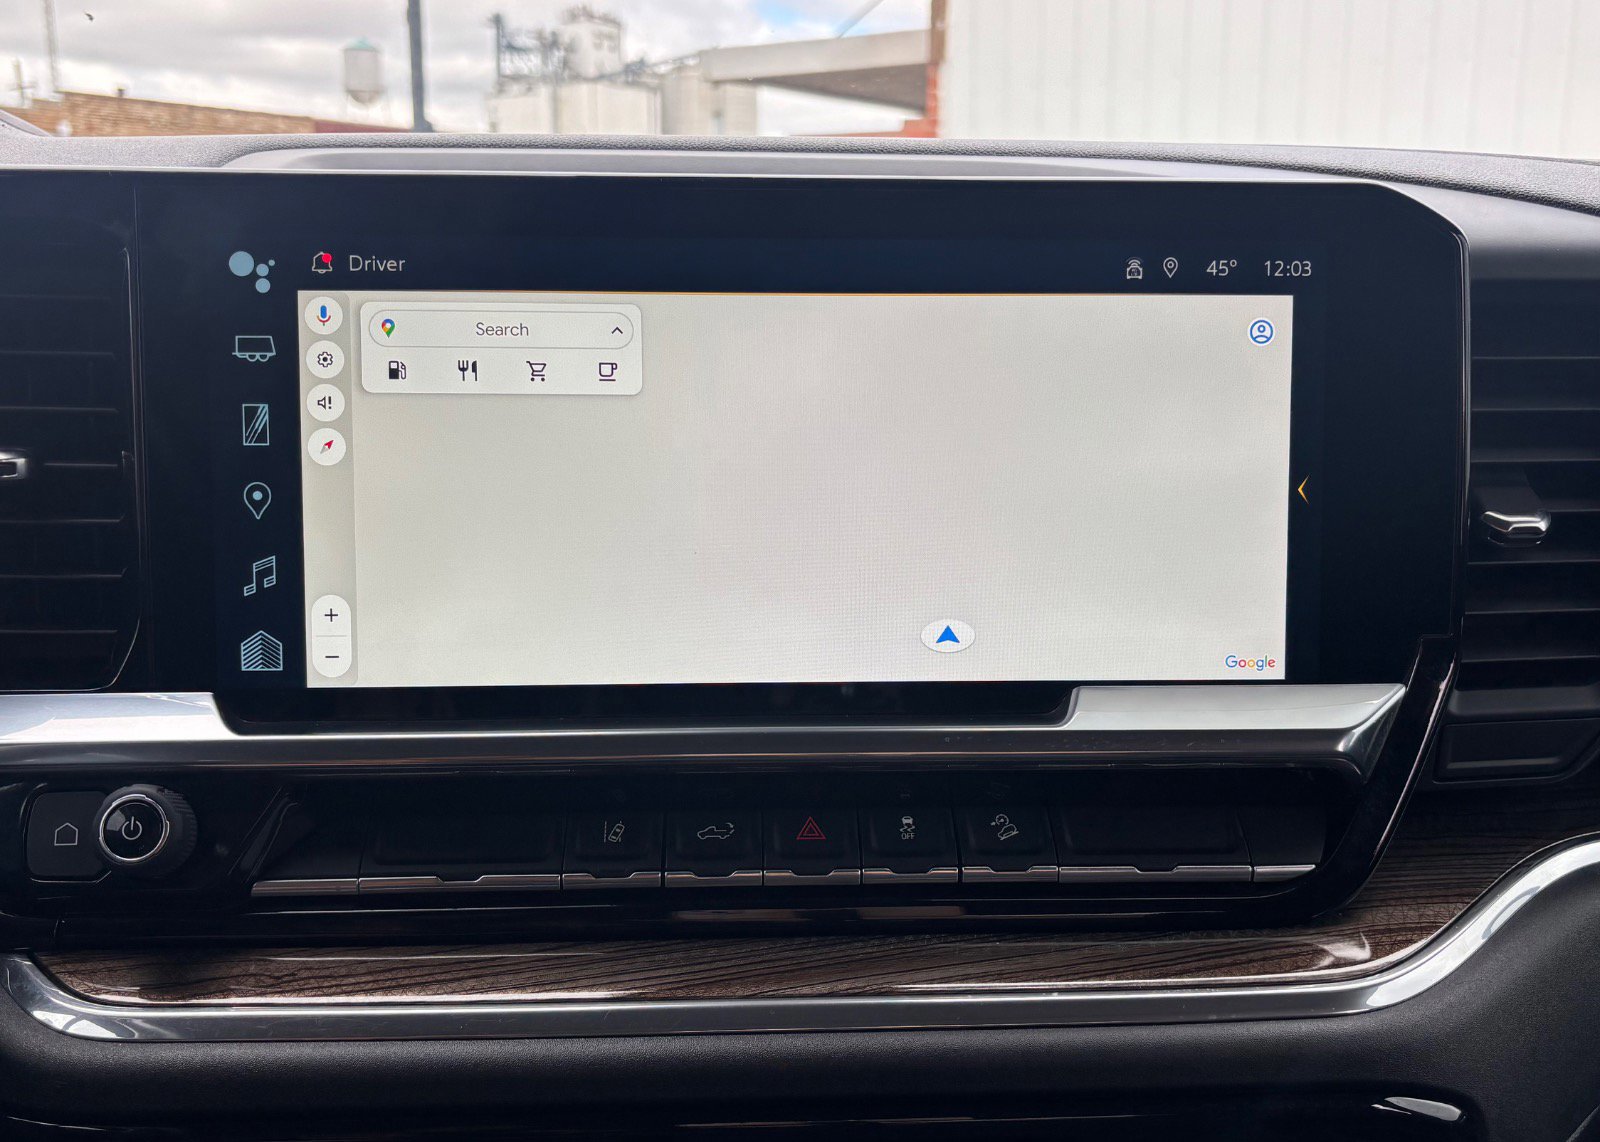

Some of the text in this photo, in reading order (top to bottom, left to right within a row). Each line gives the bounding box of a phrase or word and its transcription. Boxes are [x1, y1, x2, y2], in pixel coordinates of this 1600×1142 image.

[349, 255, 405, 272] Driver
[1264, 260, 1312, 276] 12:03
[475, 322, 529, 336] Search
[1225, 655, 1275, 671] Google
[901, 832, 916, 840] OFF
